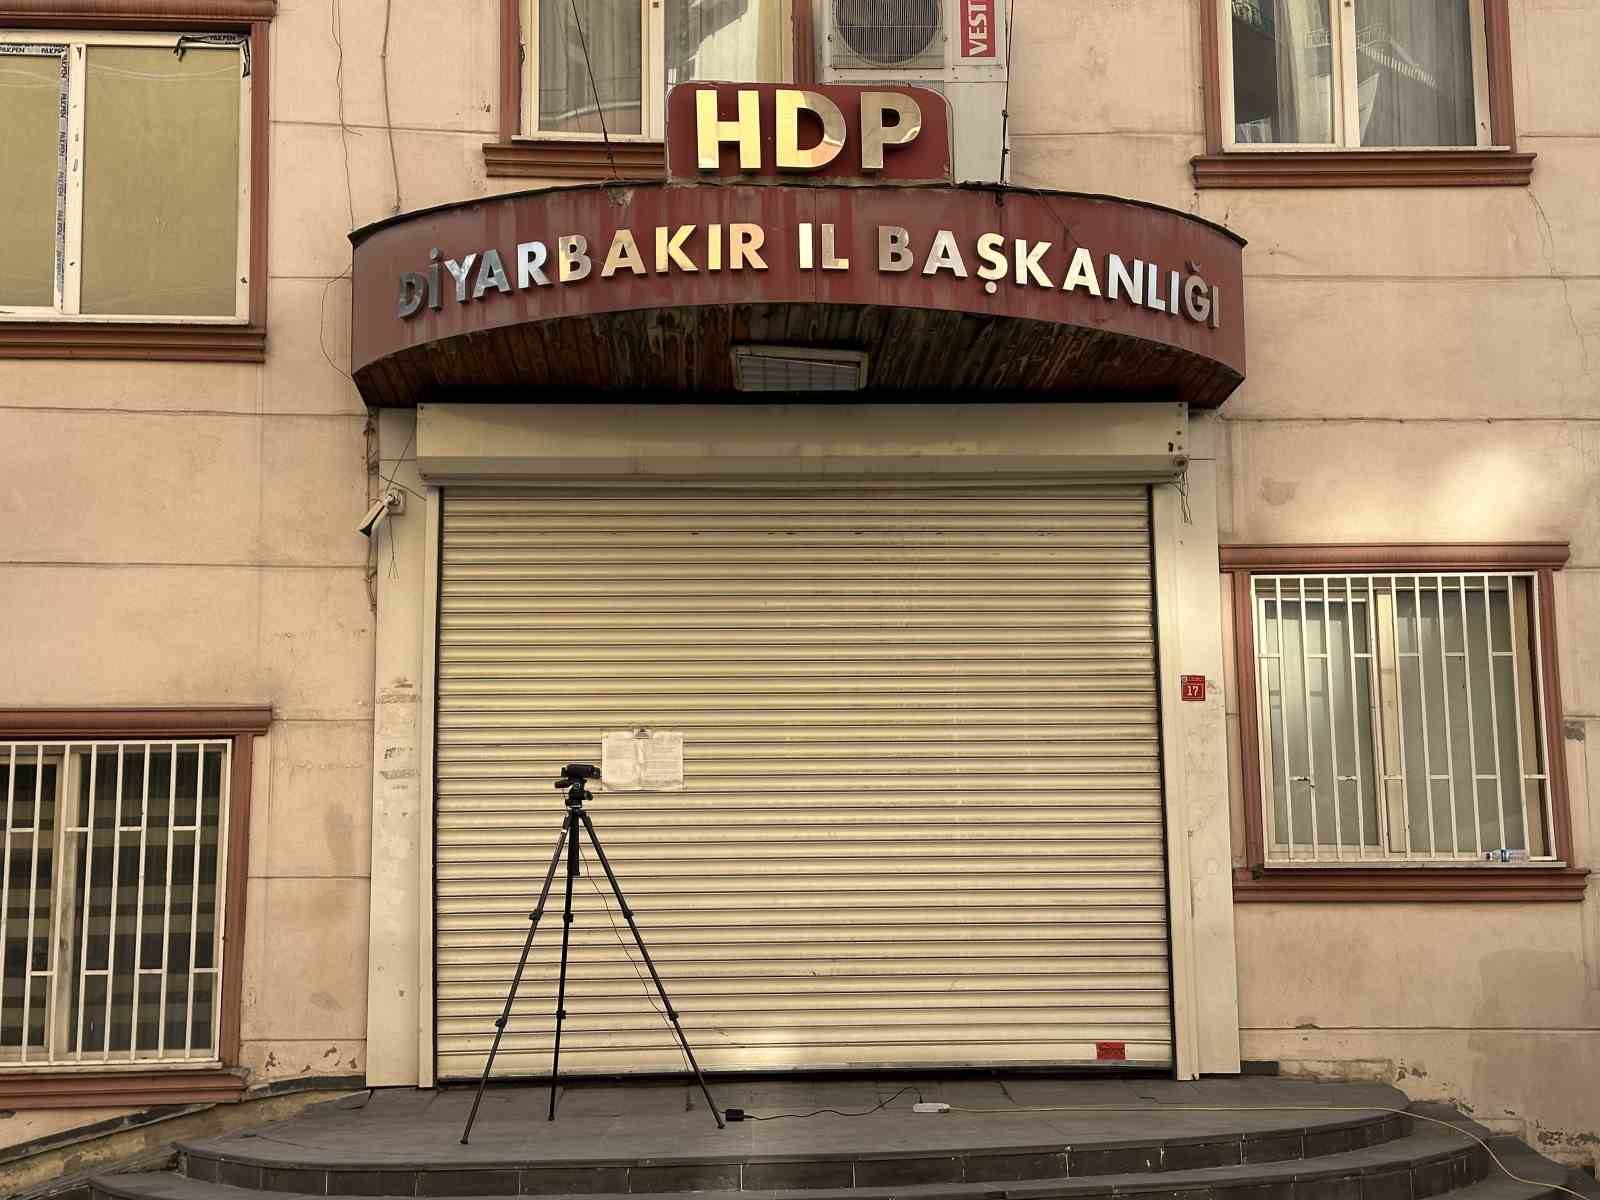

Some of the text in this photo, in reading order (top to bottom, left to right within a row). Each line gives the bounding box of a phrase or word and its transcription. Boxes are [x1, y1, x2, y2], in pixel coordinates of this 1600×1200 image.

[695, 88, 922, 170] HDP
[398, 222, 769, 319] DİYARBAKIR
[877, 224, 1220, 328] BAŞKANLIĞI
[1186, 685, 1199, 697] 17
